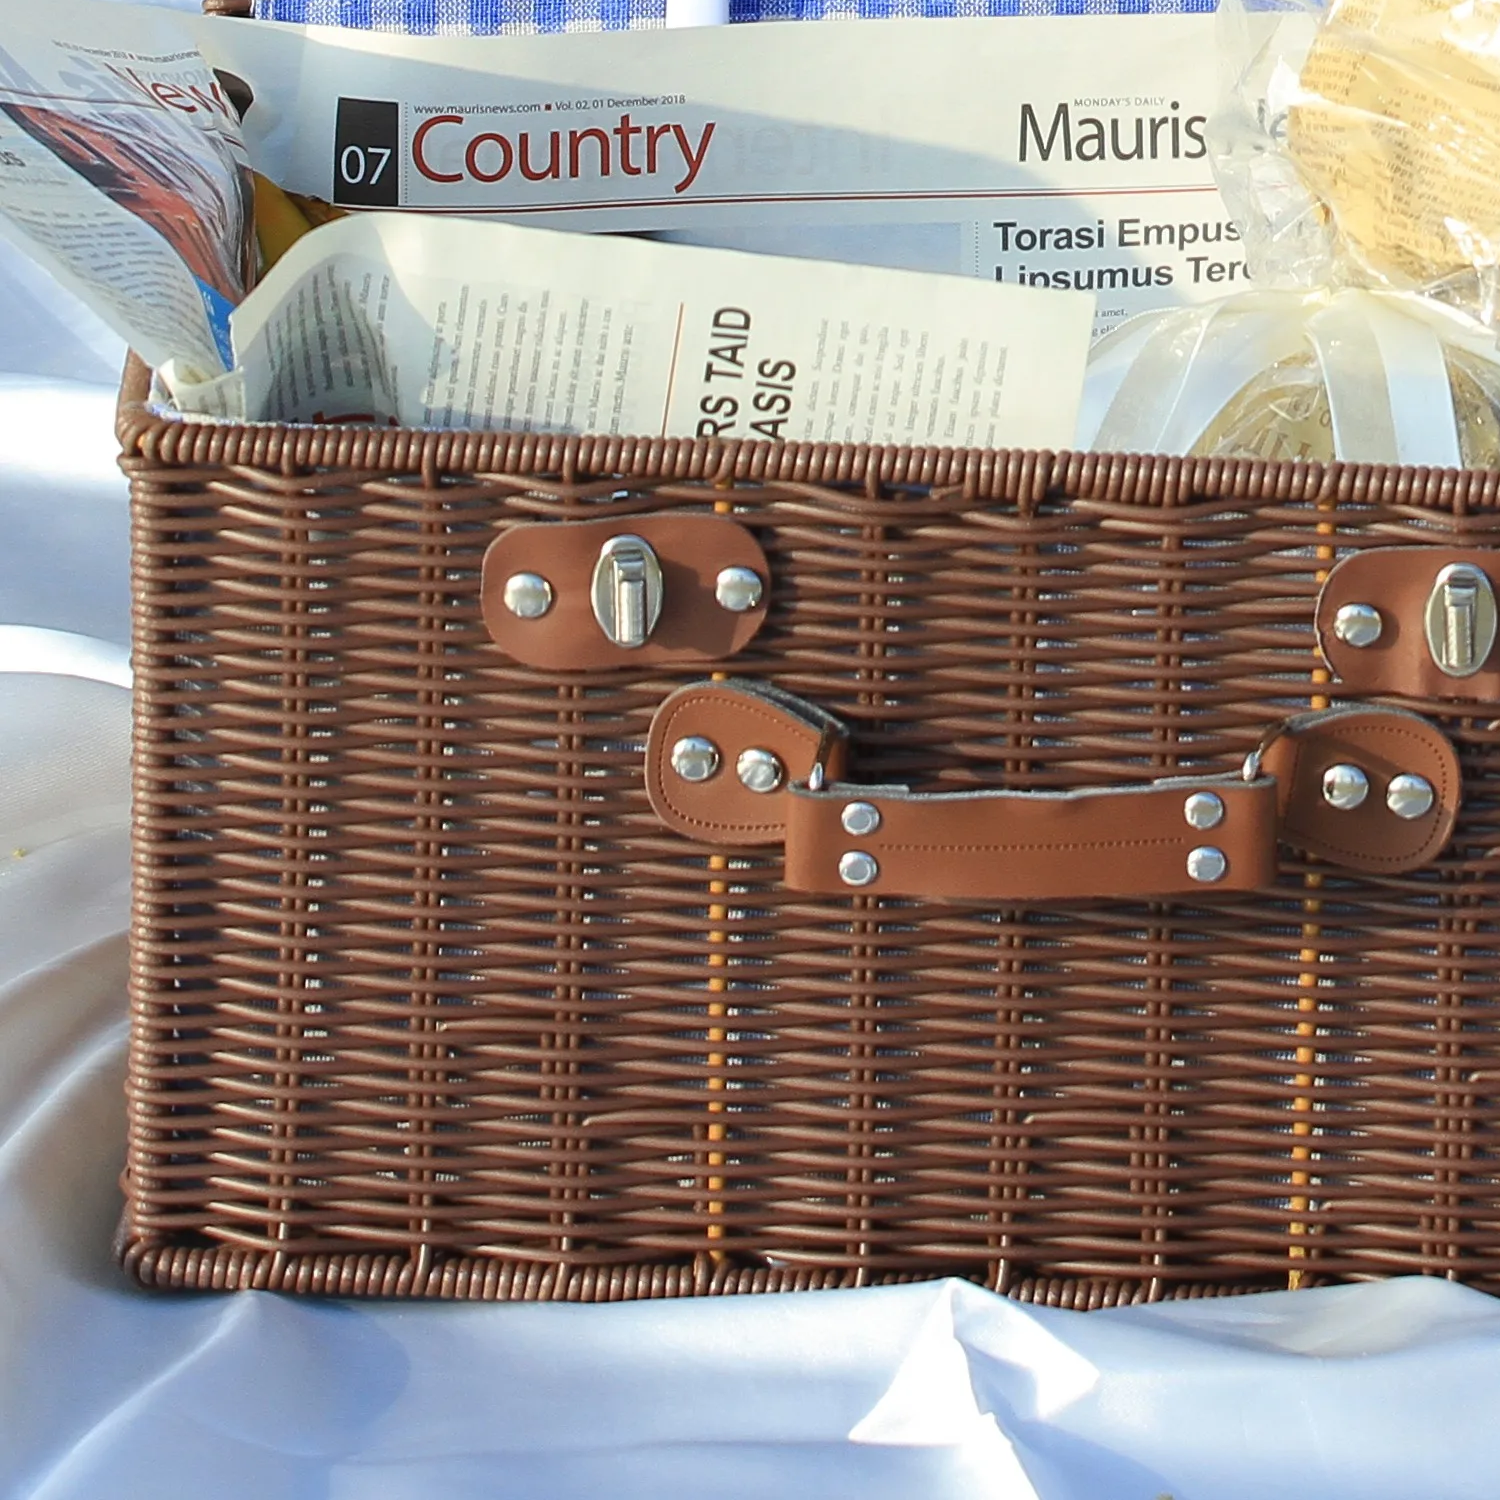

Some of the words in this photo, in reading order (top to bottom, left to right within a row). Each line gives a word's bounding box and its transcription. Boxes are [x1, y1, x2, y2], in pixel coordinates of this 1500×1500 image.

[414, 102, 541, 115] www.maurisnews.com
[593, 100, 605, 109] 01
[607, 96, 658, 108] December
[660, 95, 686, 105] 2018
[1074, 98, 1131, 107] MONDAY'S
[1134, 97, 1165, 106] DAILY
[1018, 101, 1208, 162] Mauris
[339, 144, 392, 186] 07
[412, 113, 717, 194] Country
[993, 219, 1105, 252] Torasi
[1117, 217, 1241, 251] Empus
[706, 304, 753, 381] TAID
